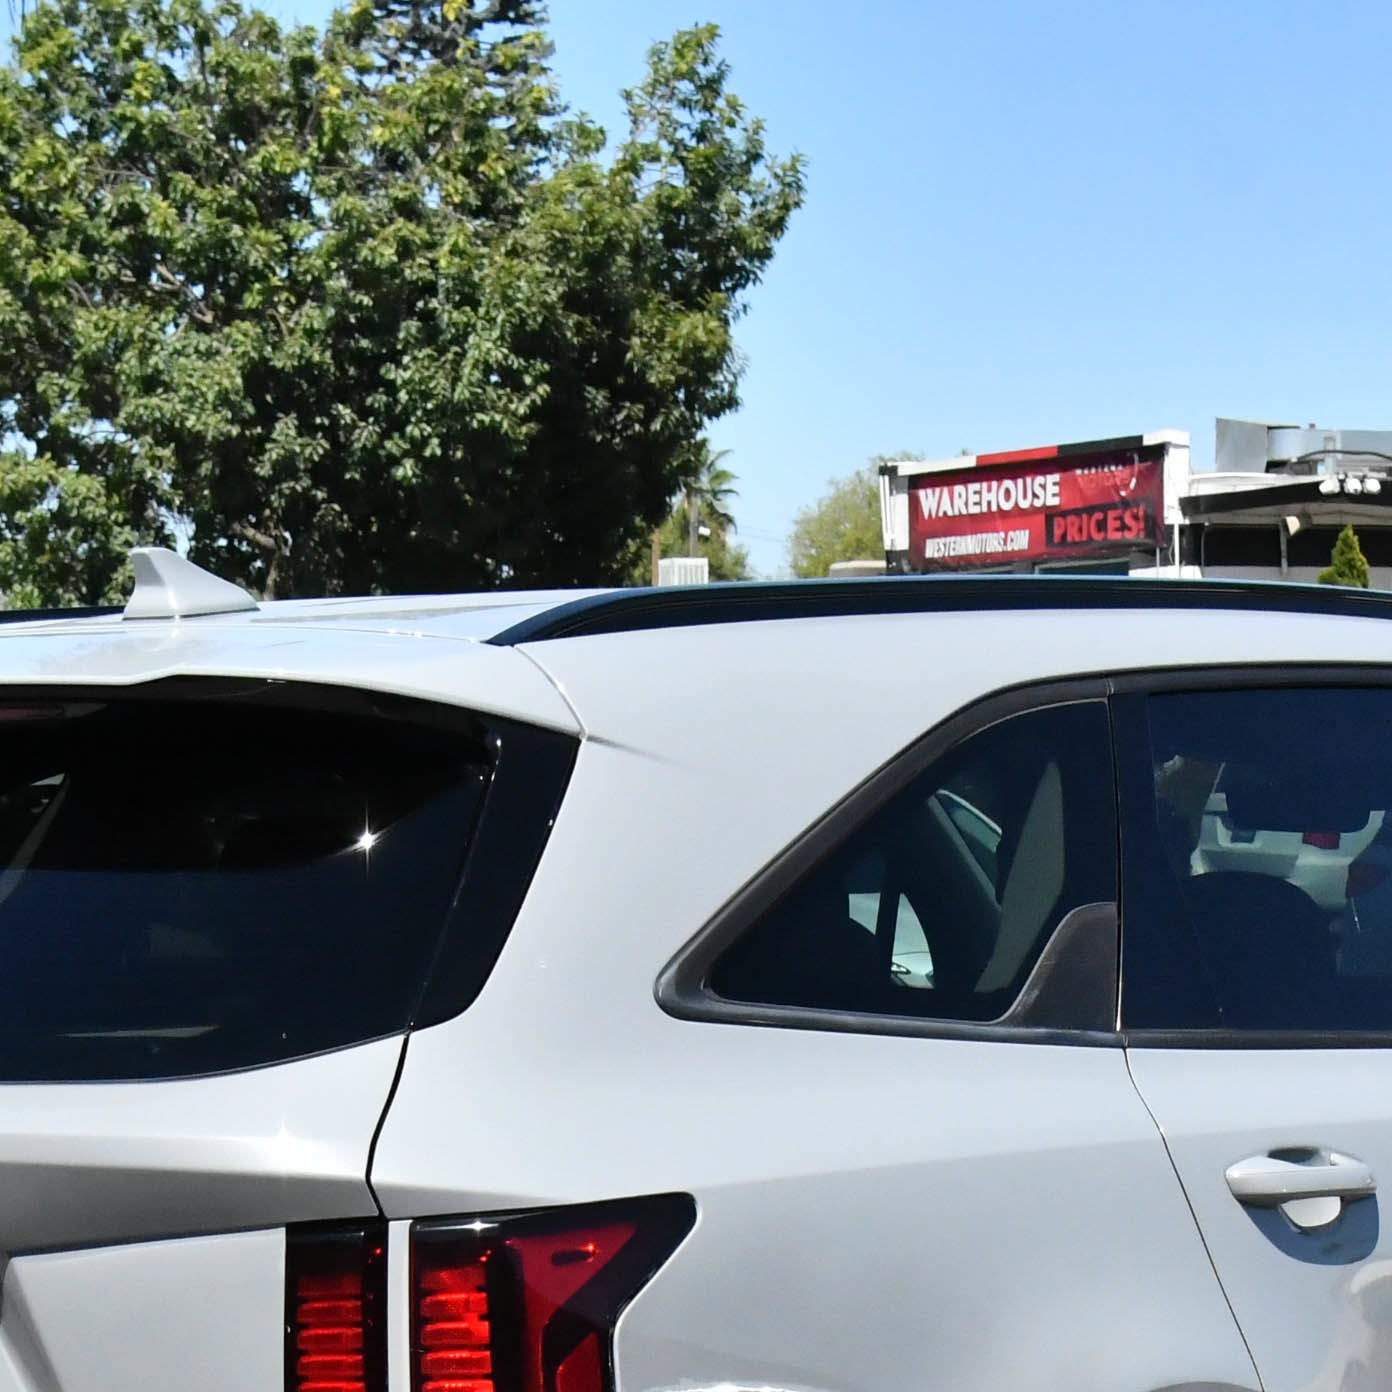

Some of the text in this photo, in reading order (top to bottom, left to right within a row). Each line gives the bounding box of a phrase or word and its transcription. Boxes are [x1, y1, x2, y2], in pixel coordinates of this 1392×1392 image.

[919, 473, 1061, 520] WAREHOUSE
[1053, 503, 1146, 543] PRICES!
[925, 529, 1030, 558] WESTERNMOTORS.COM
